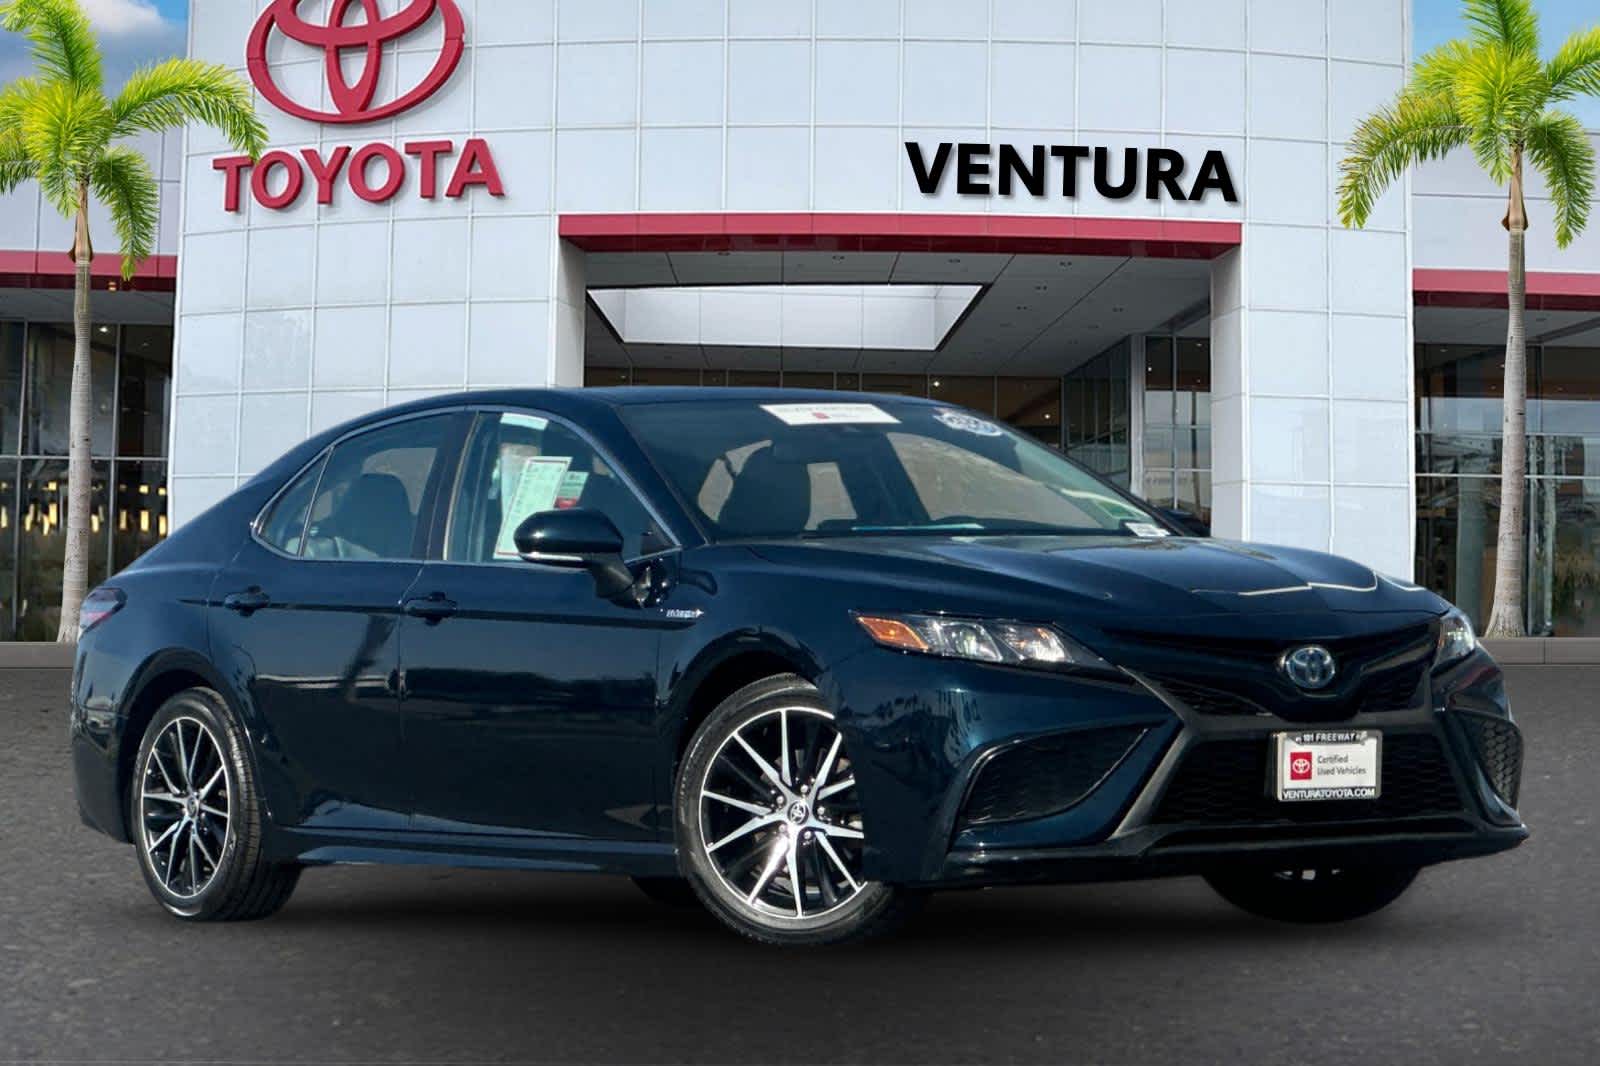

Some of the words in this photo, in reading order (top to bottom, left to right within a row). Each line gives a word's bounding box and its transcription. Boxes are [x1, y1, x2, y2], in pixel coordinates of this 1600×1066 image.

[213, 138, 504, 212] TOYOTA
[904, 141, 1239, 202] VENTURA
[1316, 732, 1355, 742] FREEWAY
[1317, 754, 1349, 764] Certified
[1317, 767, 1335, 776] Used
[1337, 766, 1366, 775] Vehicles
[1283, 788, 1375, 799] VENTURATOYOTA.COM
